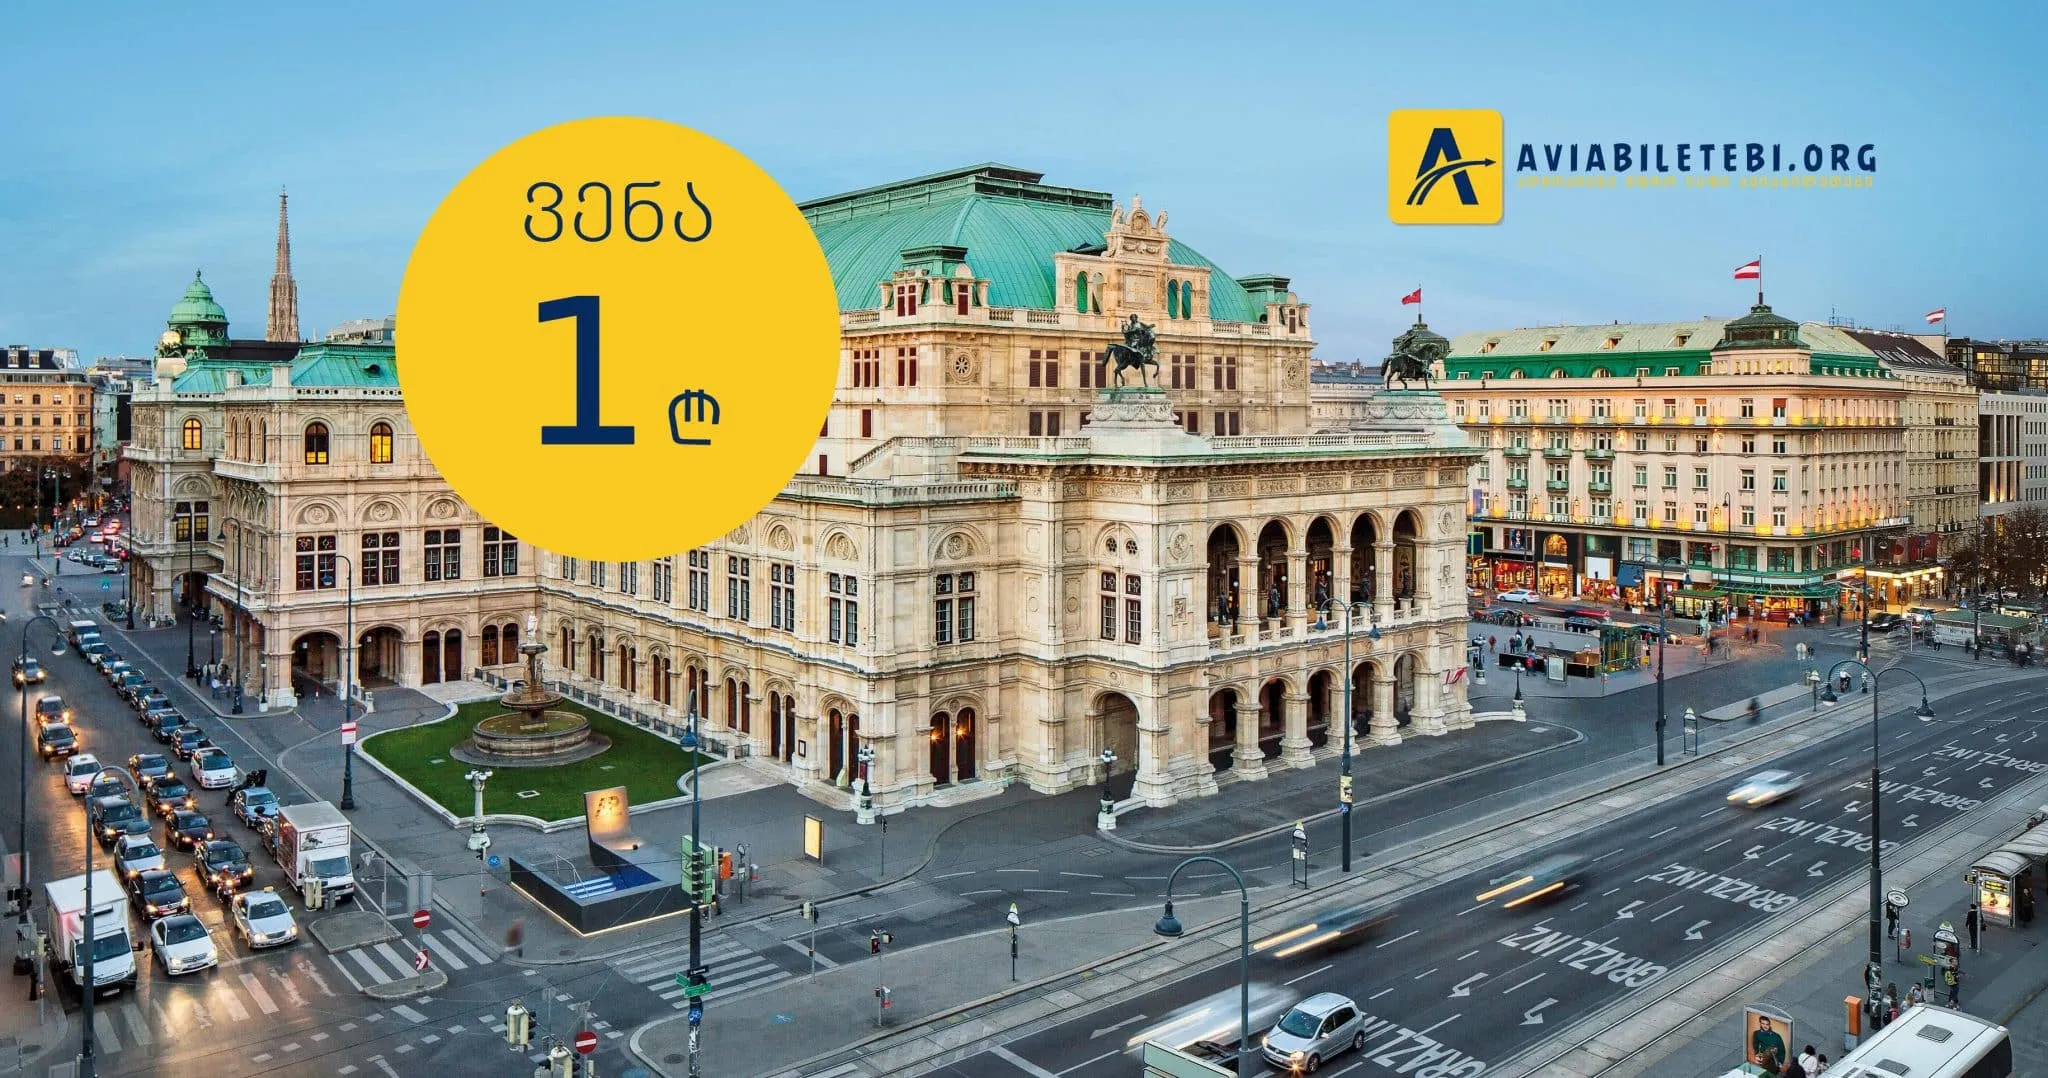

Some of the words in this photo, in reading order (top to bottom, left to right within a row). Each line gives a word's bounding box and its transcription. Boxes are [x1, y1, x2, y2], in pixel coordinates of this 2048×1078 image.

[1648, 865, 1734, 894] LINZ
[1711, 881, 1798, 913] GRAZ
[1501, 926, 1600, 963] LINZ
[1567, 946, 1668, 988] GRAZ
